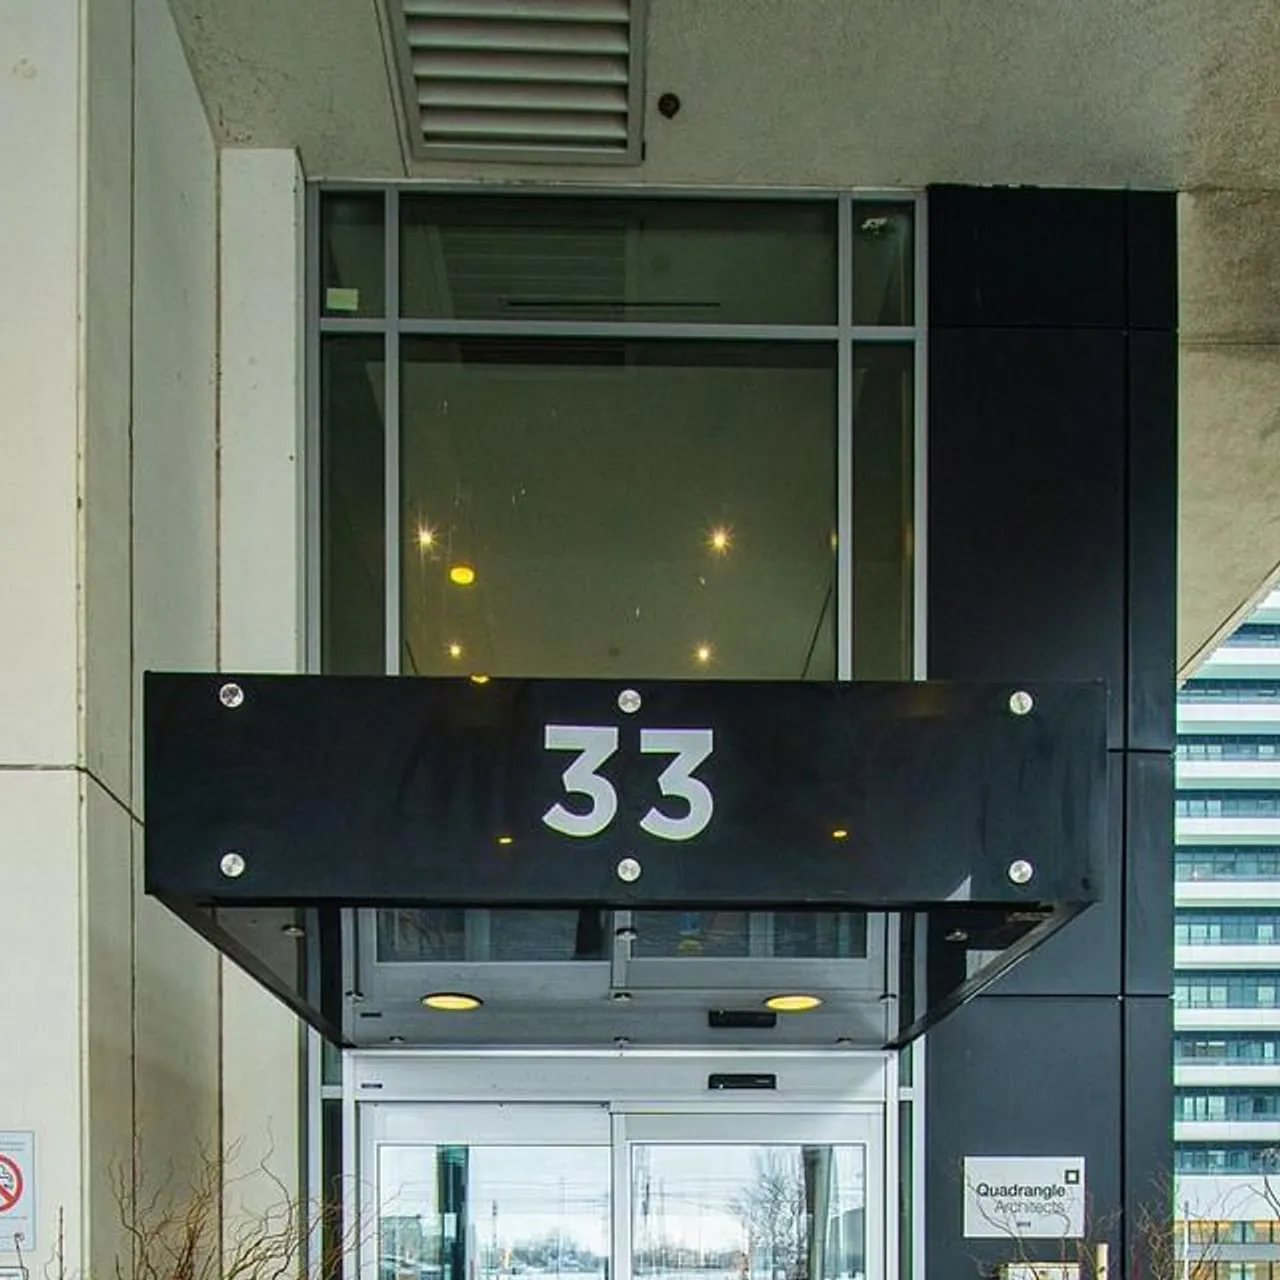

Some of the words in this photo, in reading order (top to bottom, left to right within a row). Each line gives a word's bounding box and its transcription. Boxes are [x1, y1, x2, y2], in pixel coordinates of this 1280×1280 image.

[542, 725, 714, 841] 33
[976, 1183, 1066, 1200] Quadrangle
[994, 1200, 1066, 1214] Architects
